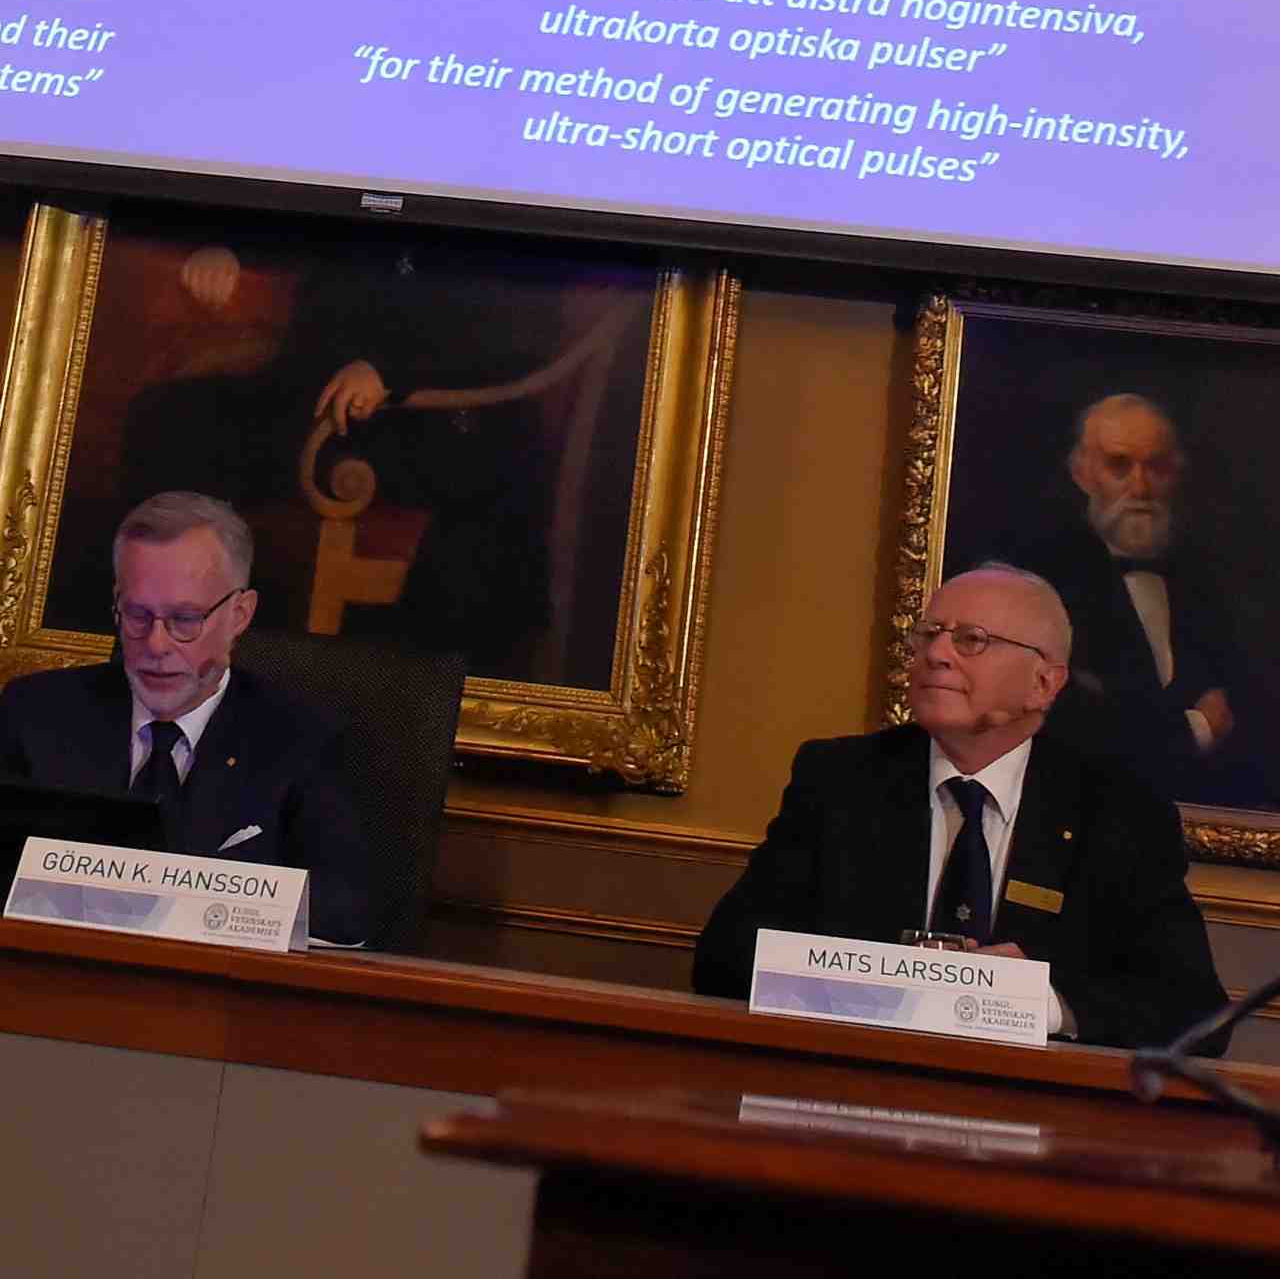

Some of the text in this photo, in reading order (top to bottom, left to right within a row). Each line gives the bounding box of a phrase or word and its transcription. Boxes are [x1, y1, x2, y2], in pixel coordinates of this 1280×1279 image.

[32, 17, 117, 53] their
[539, 4, 1008, 73] ultrakorta optiska pulser”
[354, 44, 1189, 160] “for their method of generating high-intensity,
[523, 110, 1001, 182] ultra-short optical pulses”
[42, 851, 279, 899] GÖRAN K. HANSSON
[808, 948, 994, 988] MATS LARSSON
